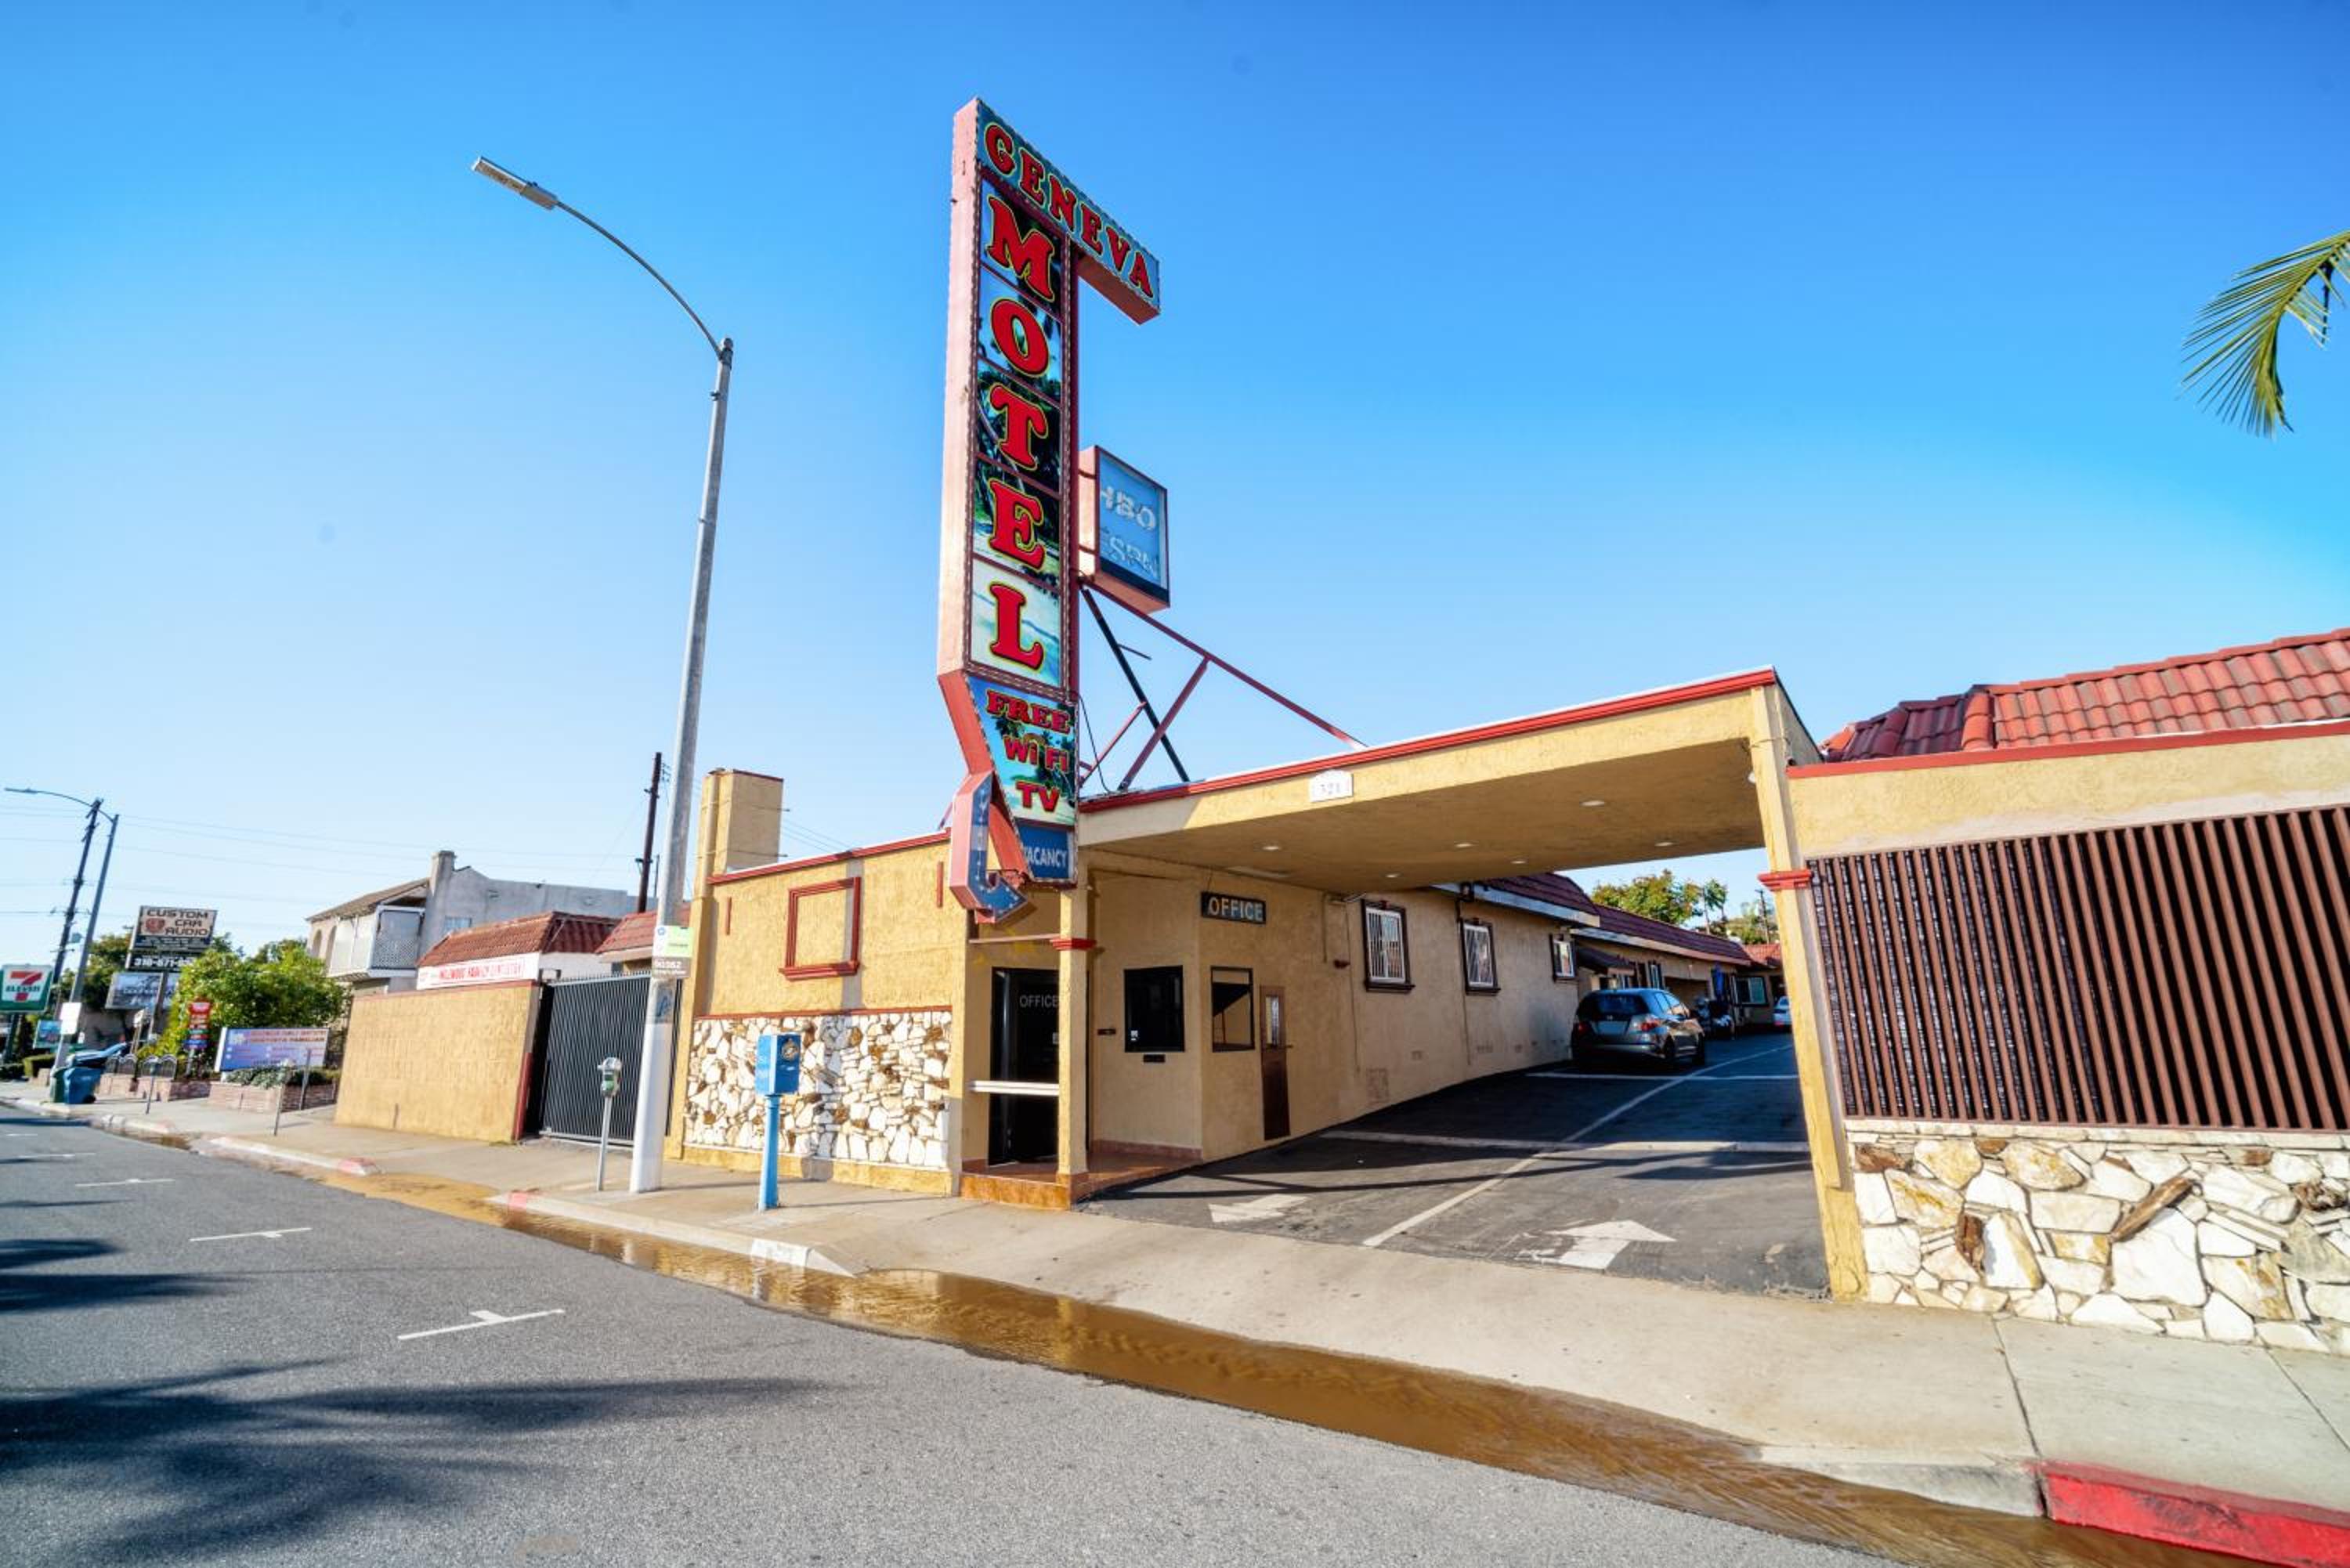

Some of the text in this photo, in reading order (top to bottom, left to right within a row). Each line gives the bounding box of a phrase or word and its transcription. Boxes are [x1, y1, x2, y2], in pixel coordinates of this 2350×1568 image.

[984, 123, 1154, 299] GENEVA
[988, 195, 1056, 671] MOTEL
[986, 689, 1071, 735] FREE
[1015, 779, 1061, 813] TV
[146, 909, 208, 919] CUSTOM
[1207, 896, 1264, 923] OFFICE
[164, 927, 208, 936] AUDIO
[10, 970, 43, 1001] 7
